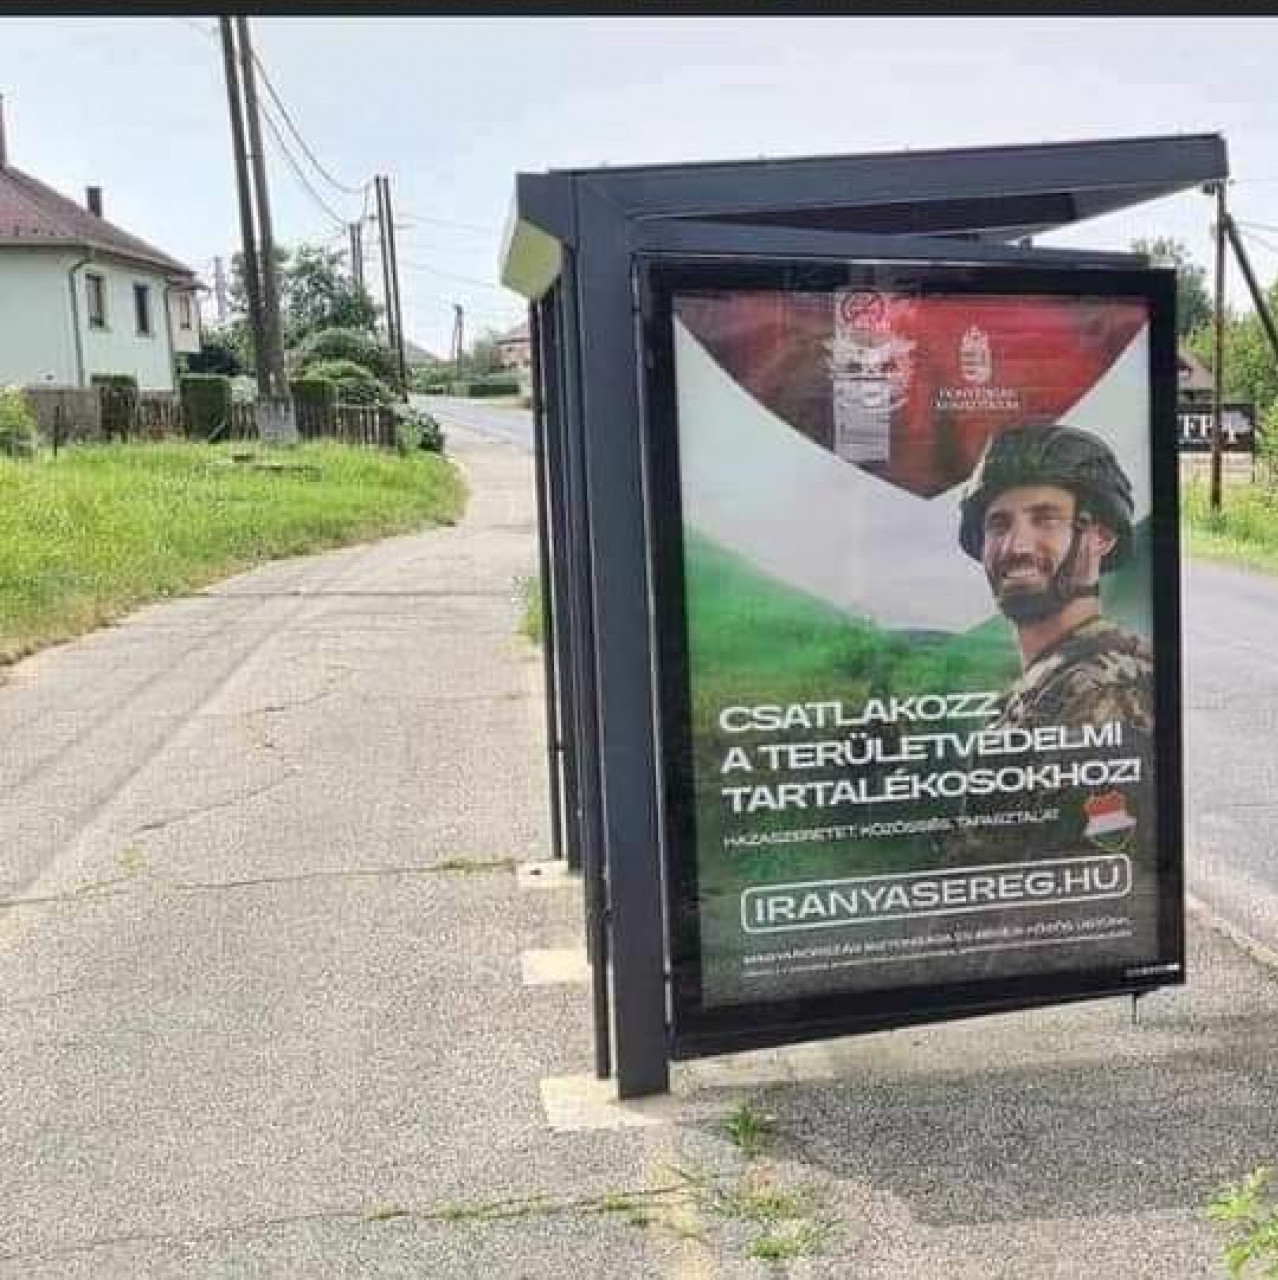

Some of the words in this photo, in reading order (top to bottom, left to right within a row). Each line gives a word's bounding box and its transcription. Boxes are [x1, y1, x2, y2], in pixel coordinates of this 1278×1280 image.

[719, 692, 1002, 733] CSATLAKOZZ
[720, 746, 754, 774] A
[757, 721, 1122, 771] TERÜLETVÉDELMI
[721, 758, 1142, 814] TARTALÉKOSOKHOZ!
[754, 866, 1119, 923] IRANYASEREG.HU
